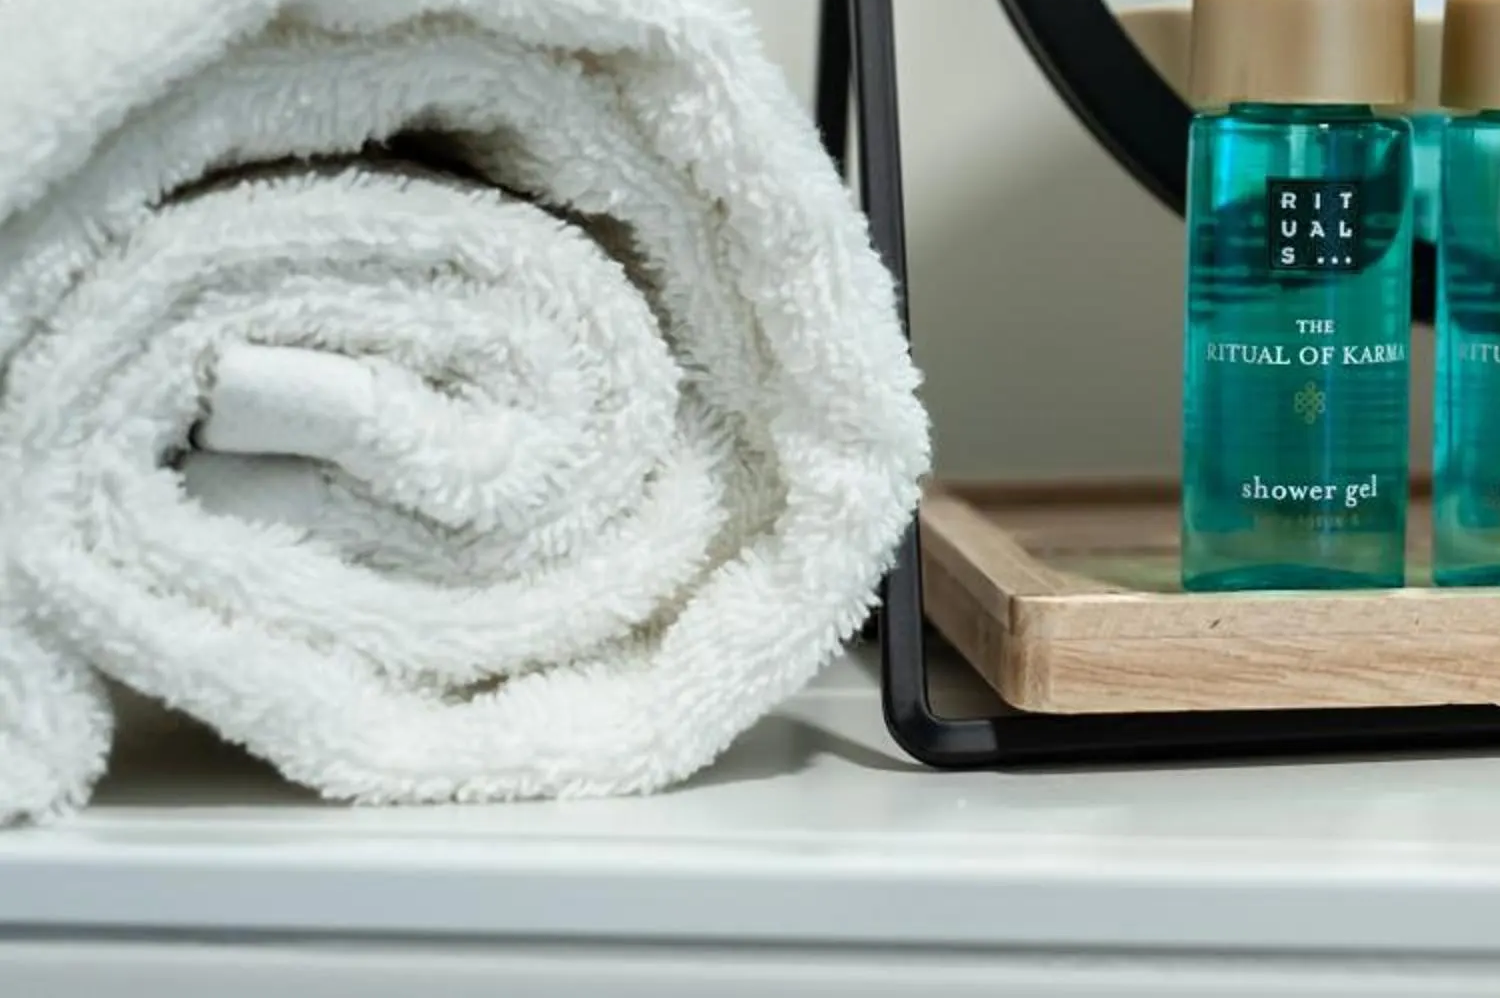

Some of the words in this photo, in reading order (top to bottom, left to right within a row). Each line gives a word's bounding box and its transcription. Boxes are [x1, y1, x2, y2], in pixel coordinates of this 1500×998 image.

[1295, 319, 1335, 334] THE
[1206, 343, 1291, 365] RITUAL
[1299, 346, 1335, 366] OF
[1241, 475, 1337, 500] shower
[1345, 474, 1377, 507] gel
